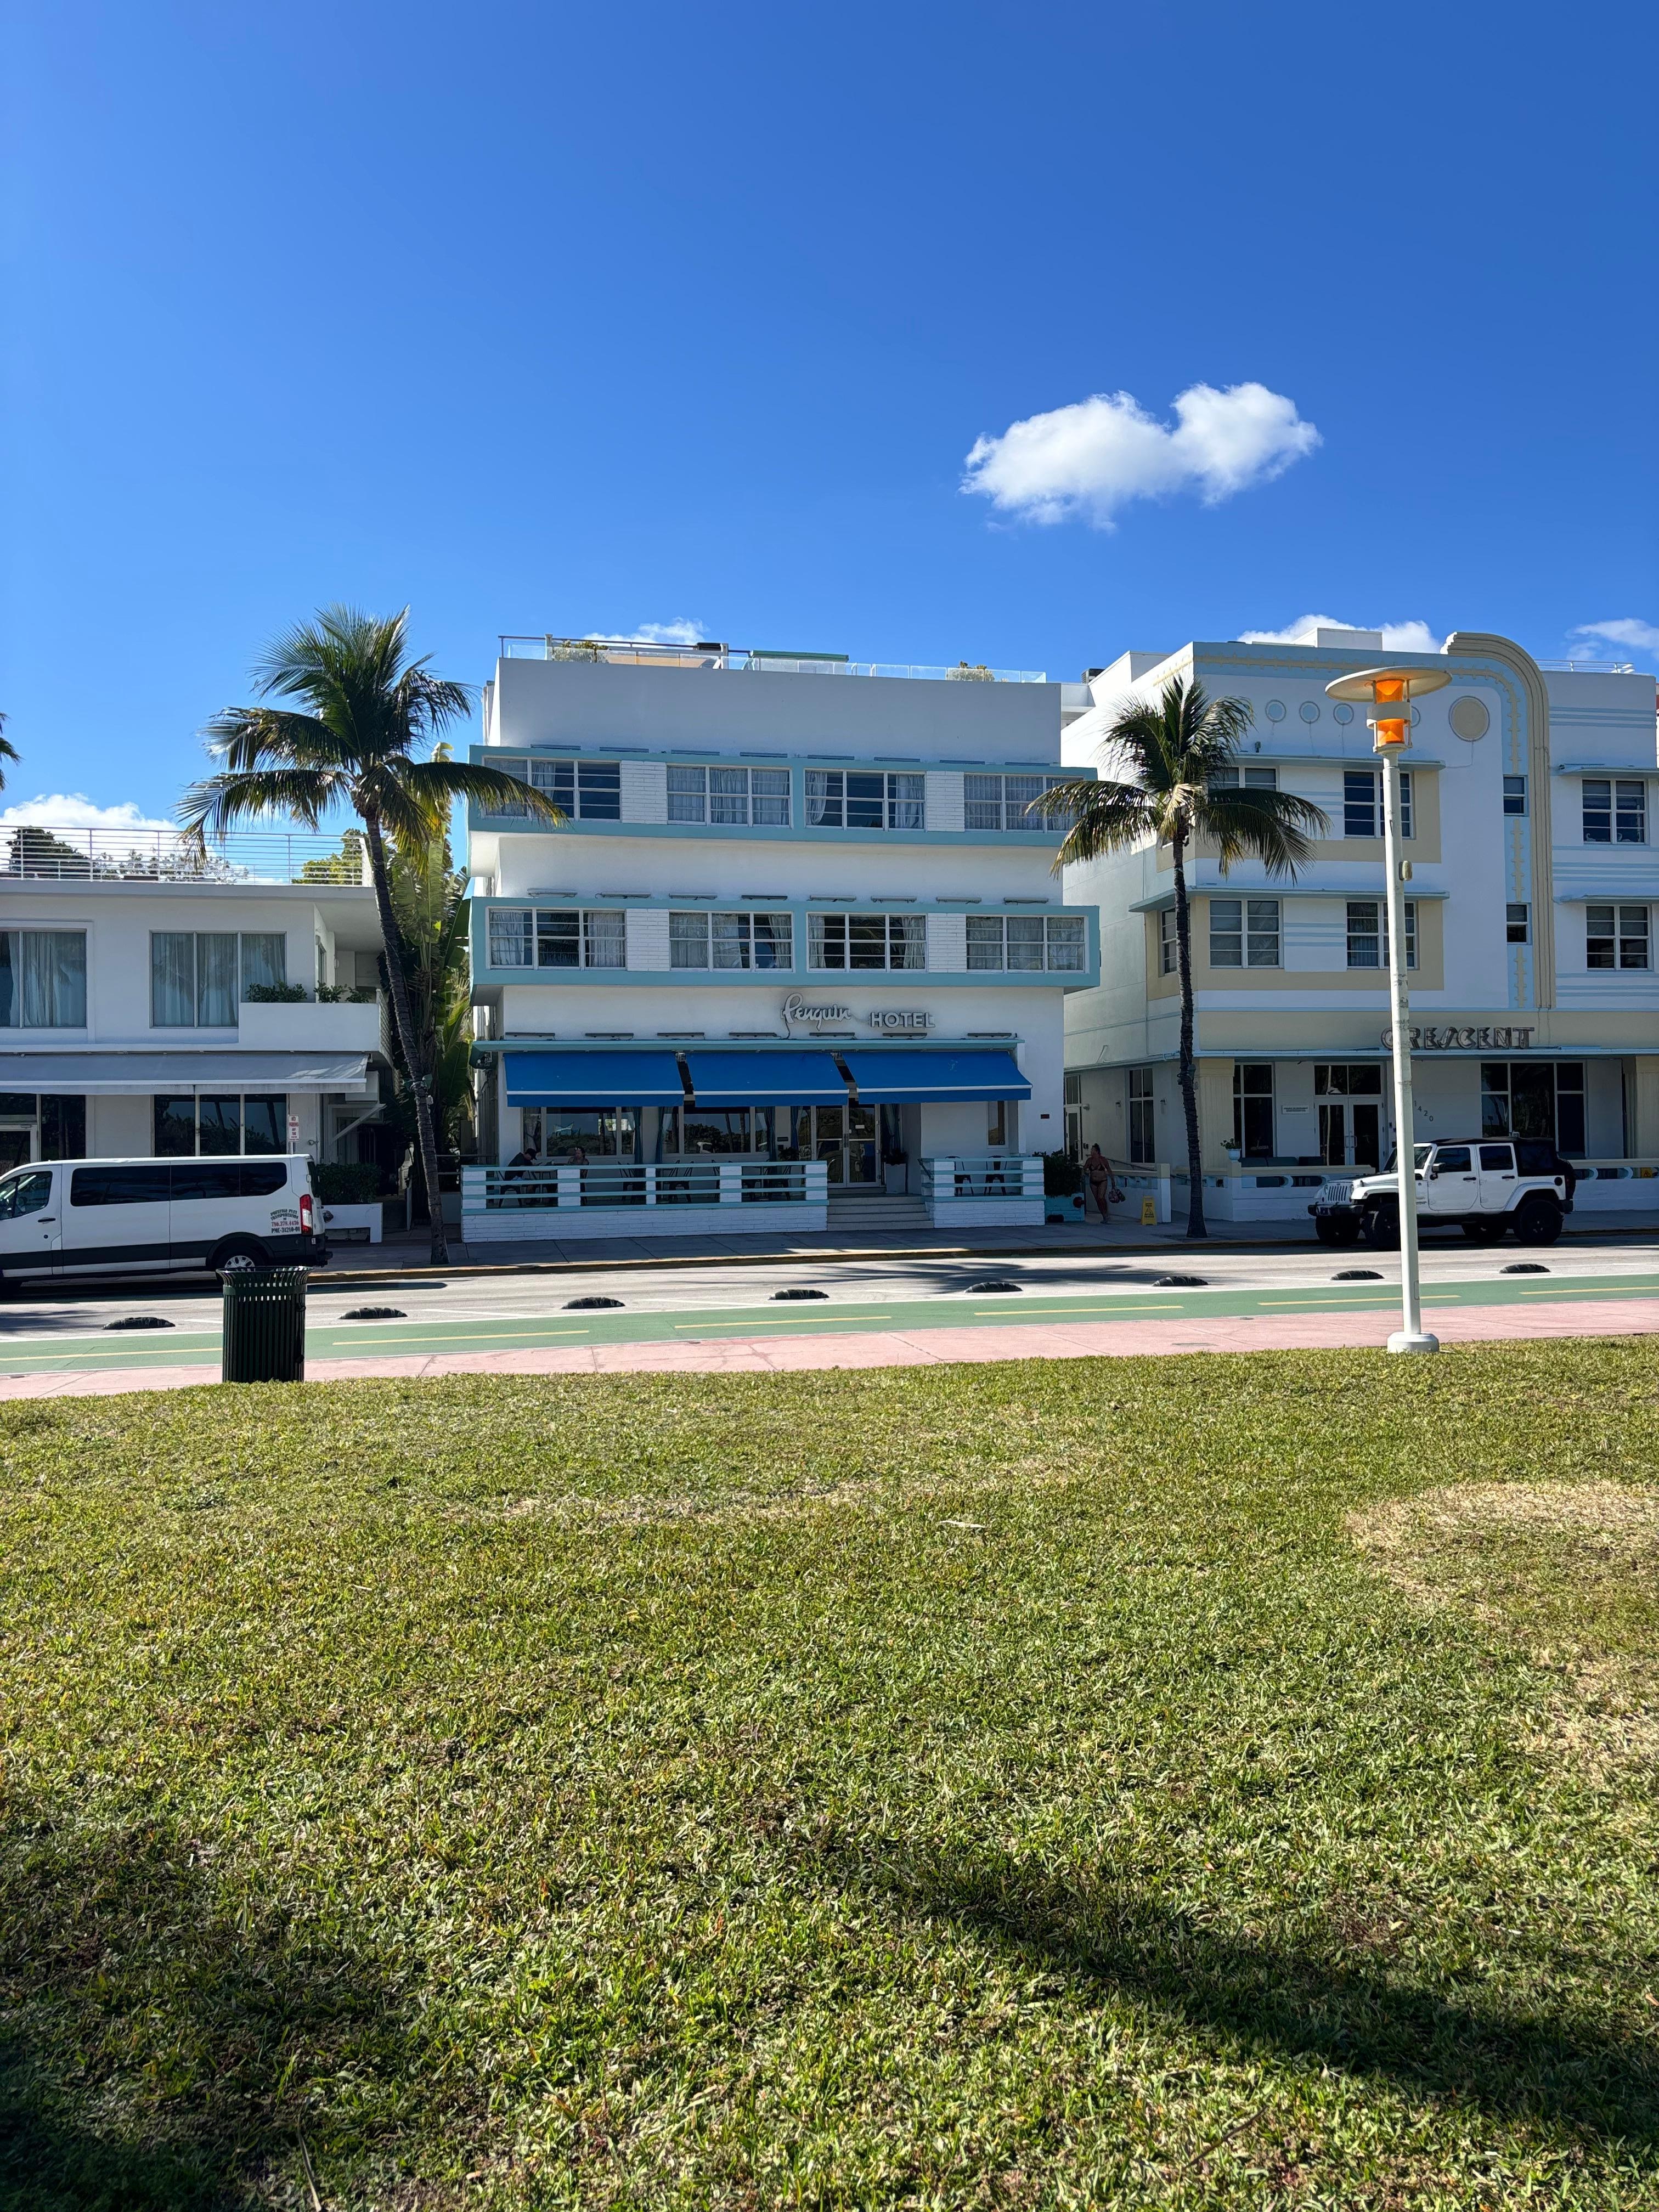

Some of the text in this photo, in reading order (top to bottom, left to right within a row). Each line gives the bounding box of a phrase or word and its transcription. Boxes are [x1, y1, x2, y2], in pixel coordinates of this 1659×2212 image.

[781, 992, 936, 1031] Penguin HOTEL
[1381, 1026, 1535, 1049] CRESCENT
[1414, 1100, 1434, 1122] 1420
